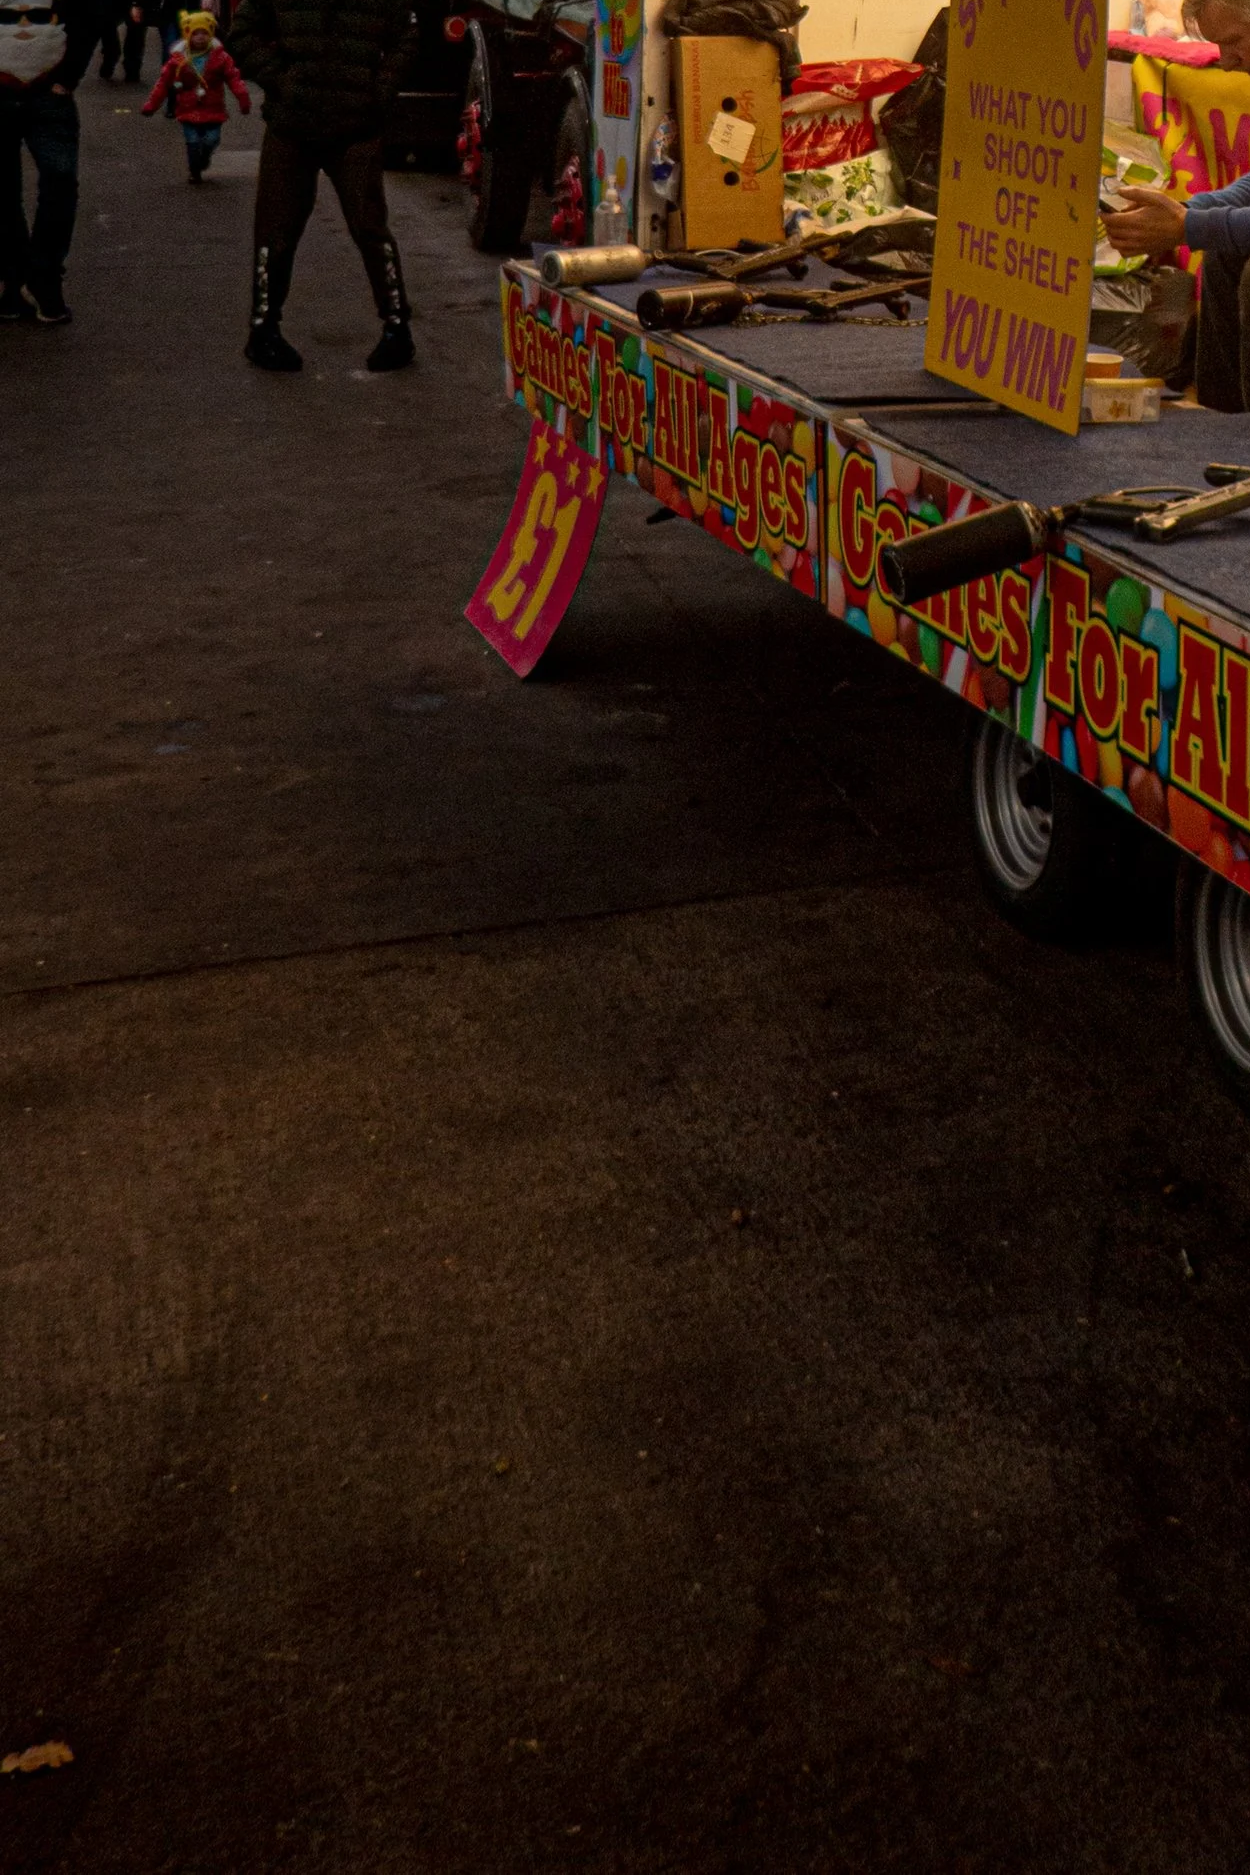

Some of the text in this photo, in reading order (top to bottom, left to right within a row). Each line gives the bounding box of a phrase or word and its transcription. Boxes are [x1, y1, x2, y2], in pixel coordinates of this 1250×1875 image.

[603, 60, 632, 119] Win
[970, 81, 1087, 144] WHAT YOU
[984, 134, 1065, 188] SHOOT
[995, 187, 1038, 234] OFF
[957, 223, 1080, 297] THE SHELF
[940, 288, 1078, 414] YOU WIN!
[507, 281, 809, 551] Games For All Ages
[486, 471, 582, 643] £1
[1043, 550, 1161, 766] For
